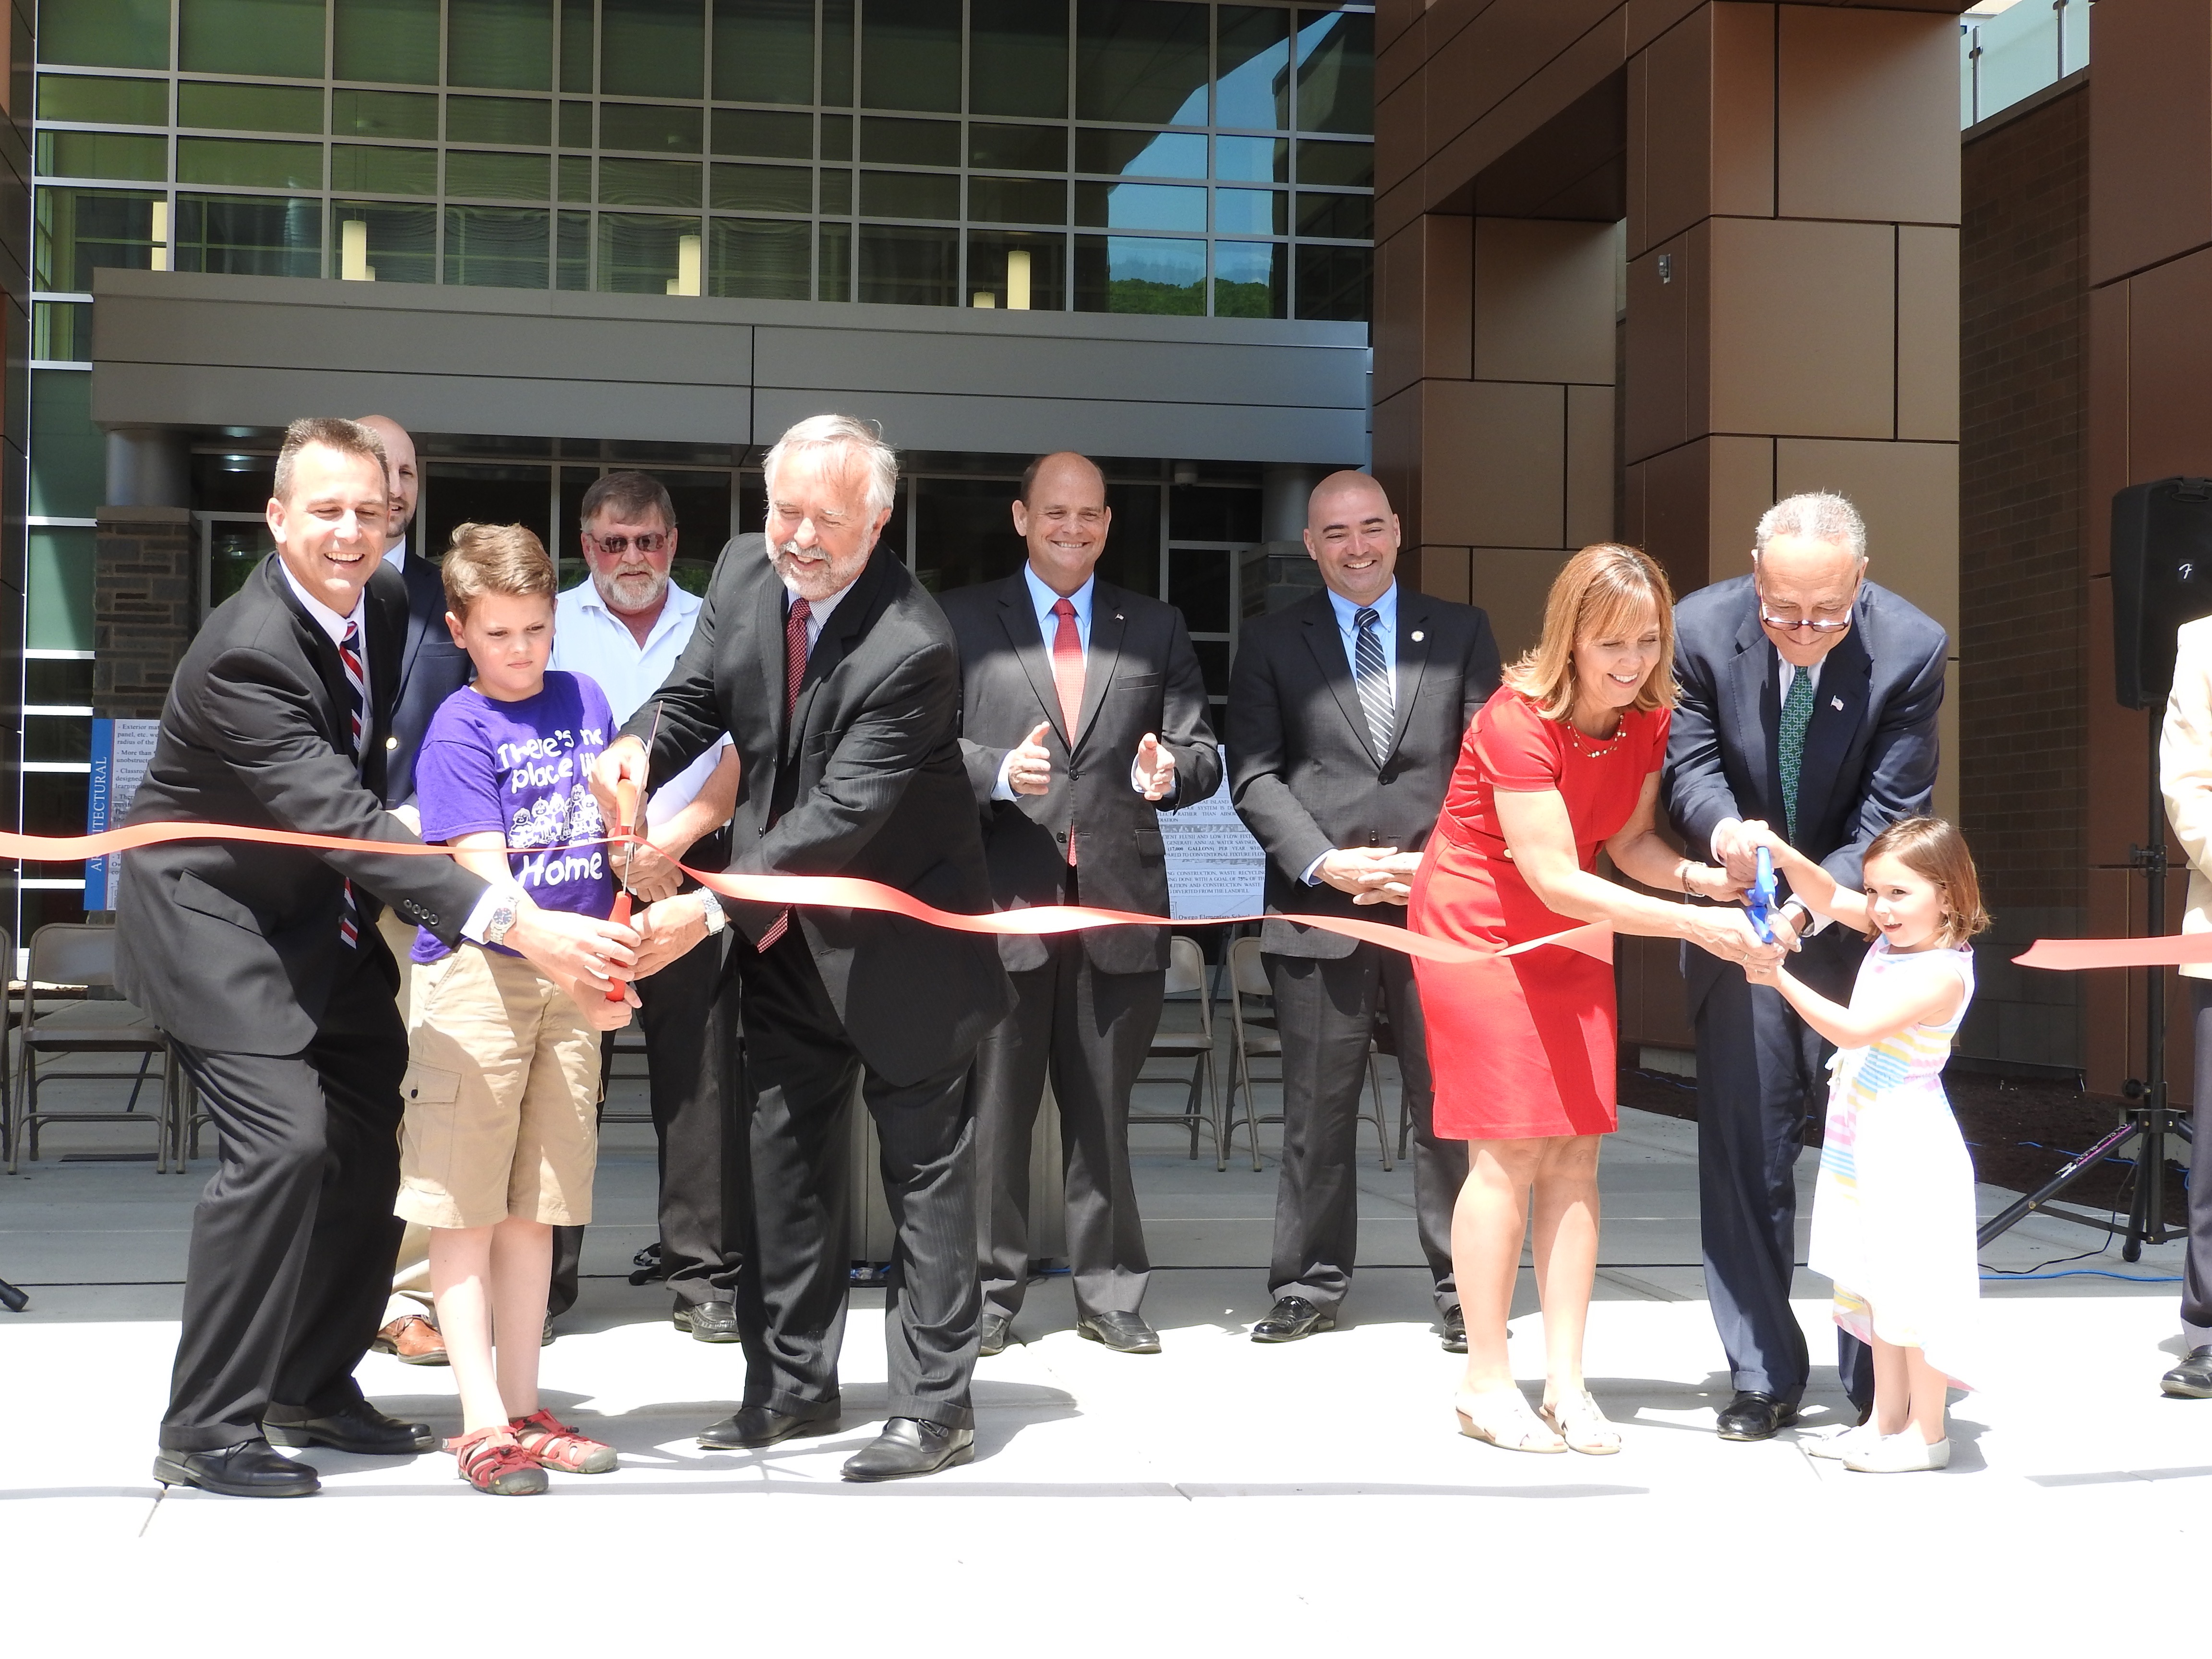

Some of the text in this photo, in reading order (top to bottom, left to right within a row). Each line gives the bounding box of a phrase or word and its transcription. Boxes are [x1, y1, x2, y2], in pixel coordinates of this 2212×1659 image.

[497, 730, 575, 769] There's
[512, 758, 573, 794] place
[518, 852, 602, 886] Home
